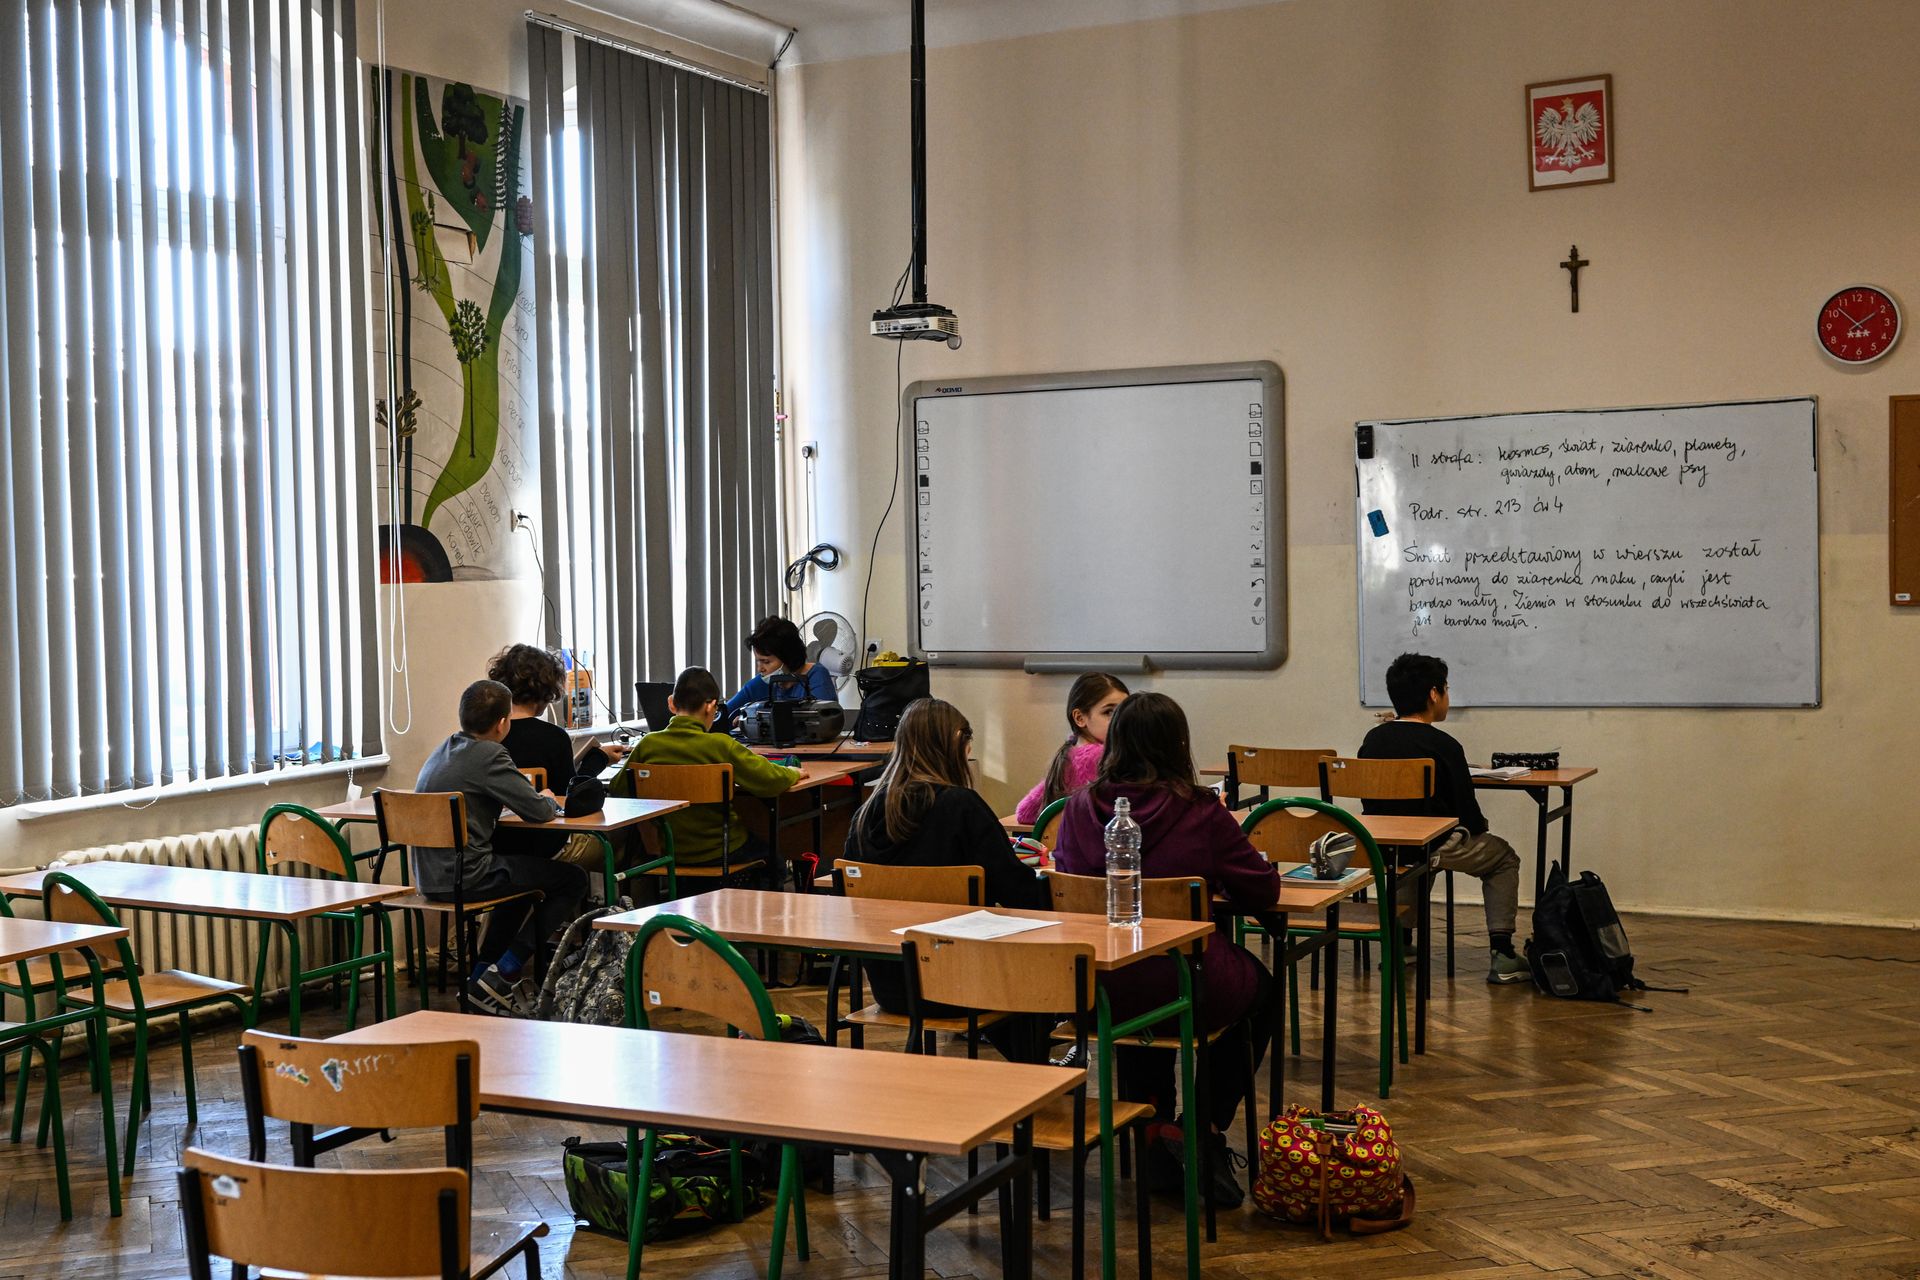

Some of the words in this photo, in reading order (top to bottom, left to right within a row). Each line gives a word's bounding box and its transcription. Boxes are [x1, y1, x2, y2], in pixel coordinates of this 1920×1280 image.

[1852, 294, 1863, 303] 12
[1870, 296, 1874, 304] 1
[1880, 305, 1886, 314] 2
[1828, 310, 1839, 318] 10
[1884, 318, 1890, 326] 3
[1826, 323, 1832, 331] 9
[1842, 345, 1847, 353] 7
[1856, 347, 1862, 355] 6
[1871, 342, 1876, 350] 5
[504, 349, 522, 380] Trias
[1611, 437, 1677, 457] ziarenko,
[1685, 437, 1746, 464] planety,
[498, 446, 523, 488] Karbon
[1501, 464, 1561, 487] gwiazdy,
[479, 482, 501, 524] Dewon
[1409, 502, 1448, 521] Podr.
[1457, 504, 1488, 518] str.
[1495, 498, 1521, 515] 213
[1554, 496, 1563, 513] 4
[465, 501, 482, 529] Sylur
[1403, 539, 1451, 564] Świat
[1465, 545, 1582, 576] przedstawiony
[1593, 548, 1605, 561] w
[1617, 544, 1684, 562] wierszu
[1702, 539, 1761, 559] został
[1408, 571, 1481, 597] porównany
[1491, 571, 1509, 585] do
[1517, 571, 1584, 586] ziarenka
[1591, 571, 1646, 591] maku,
[1650, 570, 1686, 597] czyli
[1701, 569, 1733, 596] jest
[1409, 597, 1452, 612] bardzo
[1513, 589, 1557, 610] Ziemia
[1565, 598, 1576, 608] w
[1584, 593, 1643, 609] stosunku
[1651, 596, 1671, 609] do
[1680, 594, 1771, 610] wszechświata
[1412, 614, 1432, 637] jest
[1443, 613, 1487, 628] bardzo
[1492, 613, 1538, 630] mała.
